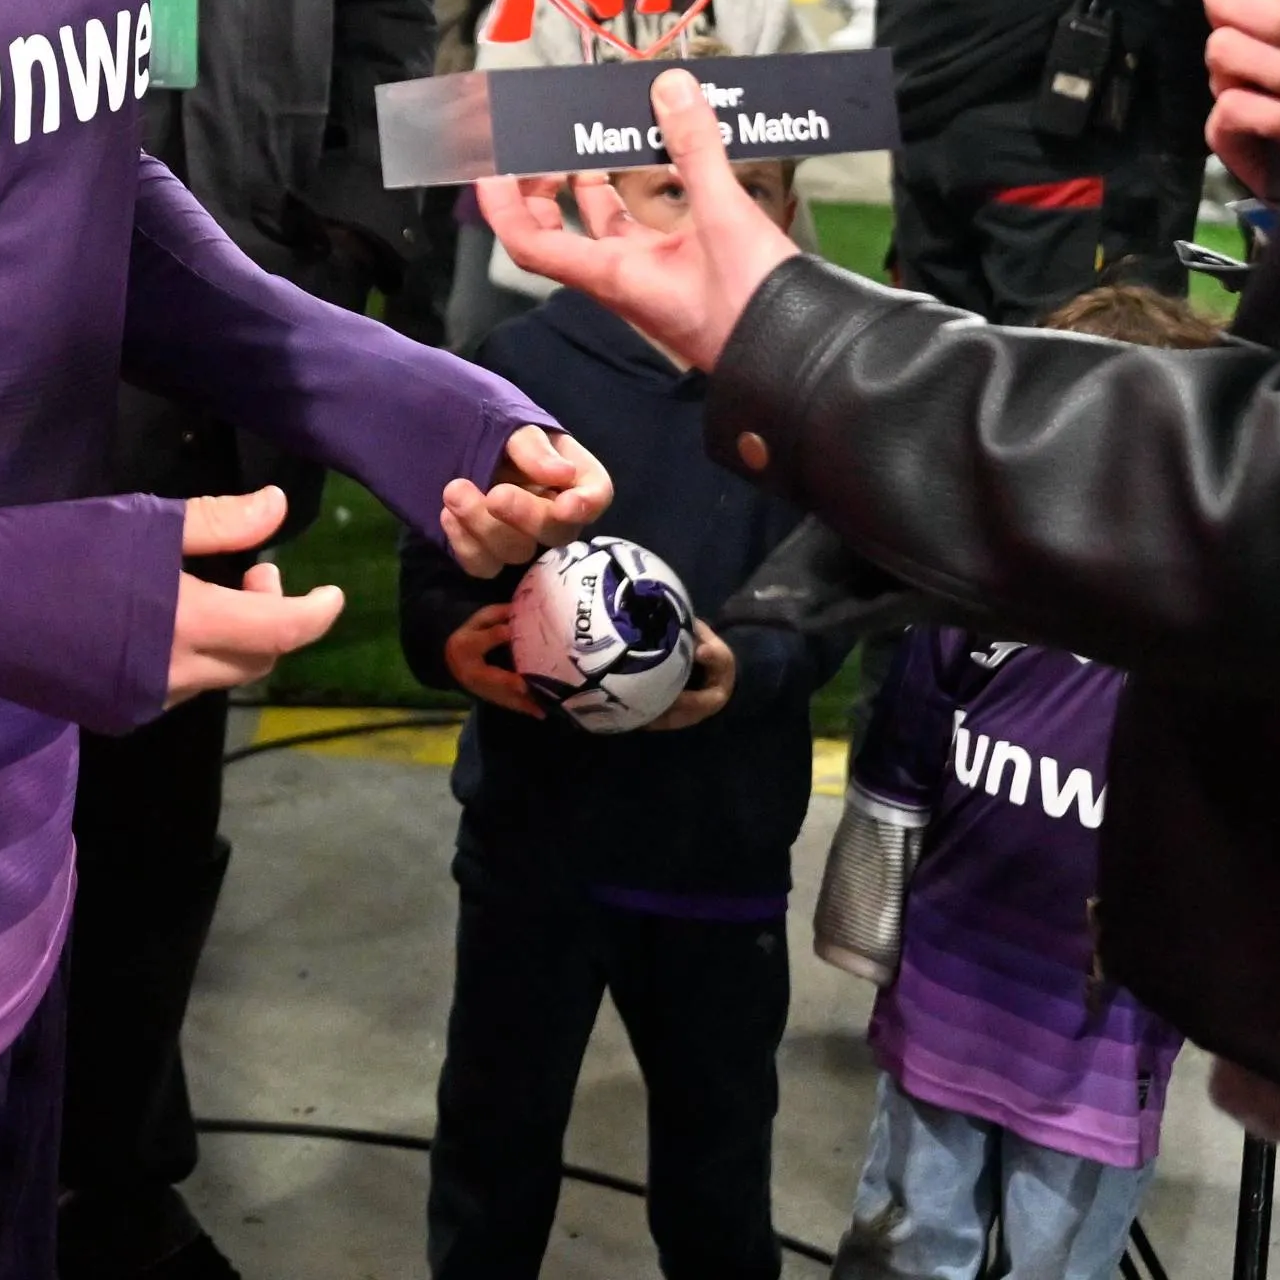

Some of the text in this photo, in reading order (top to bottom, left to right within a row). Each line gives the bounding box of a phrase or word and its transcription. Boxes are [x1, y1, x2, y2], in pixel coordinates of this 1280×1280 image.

[573, 121, 642, 155] Man
[737, 109, 831, 145] Match
[951, 709, 1108, 829] unw
